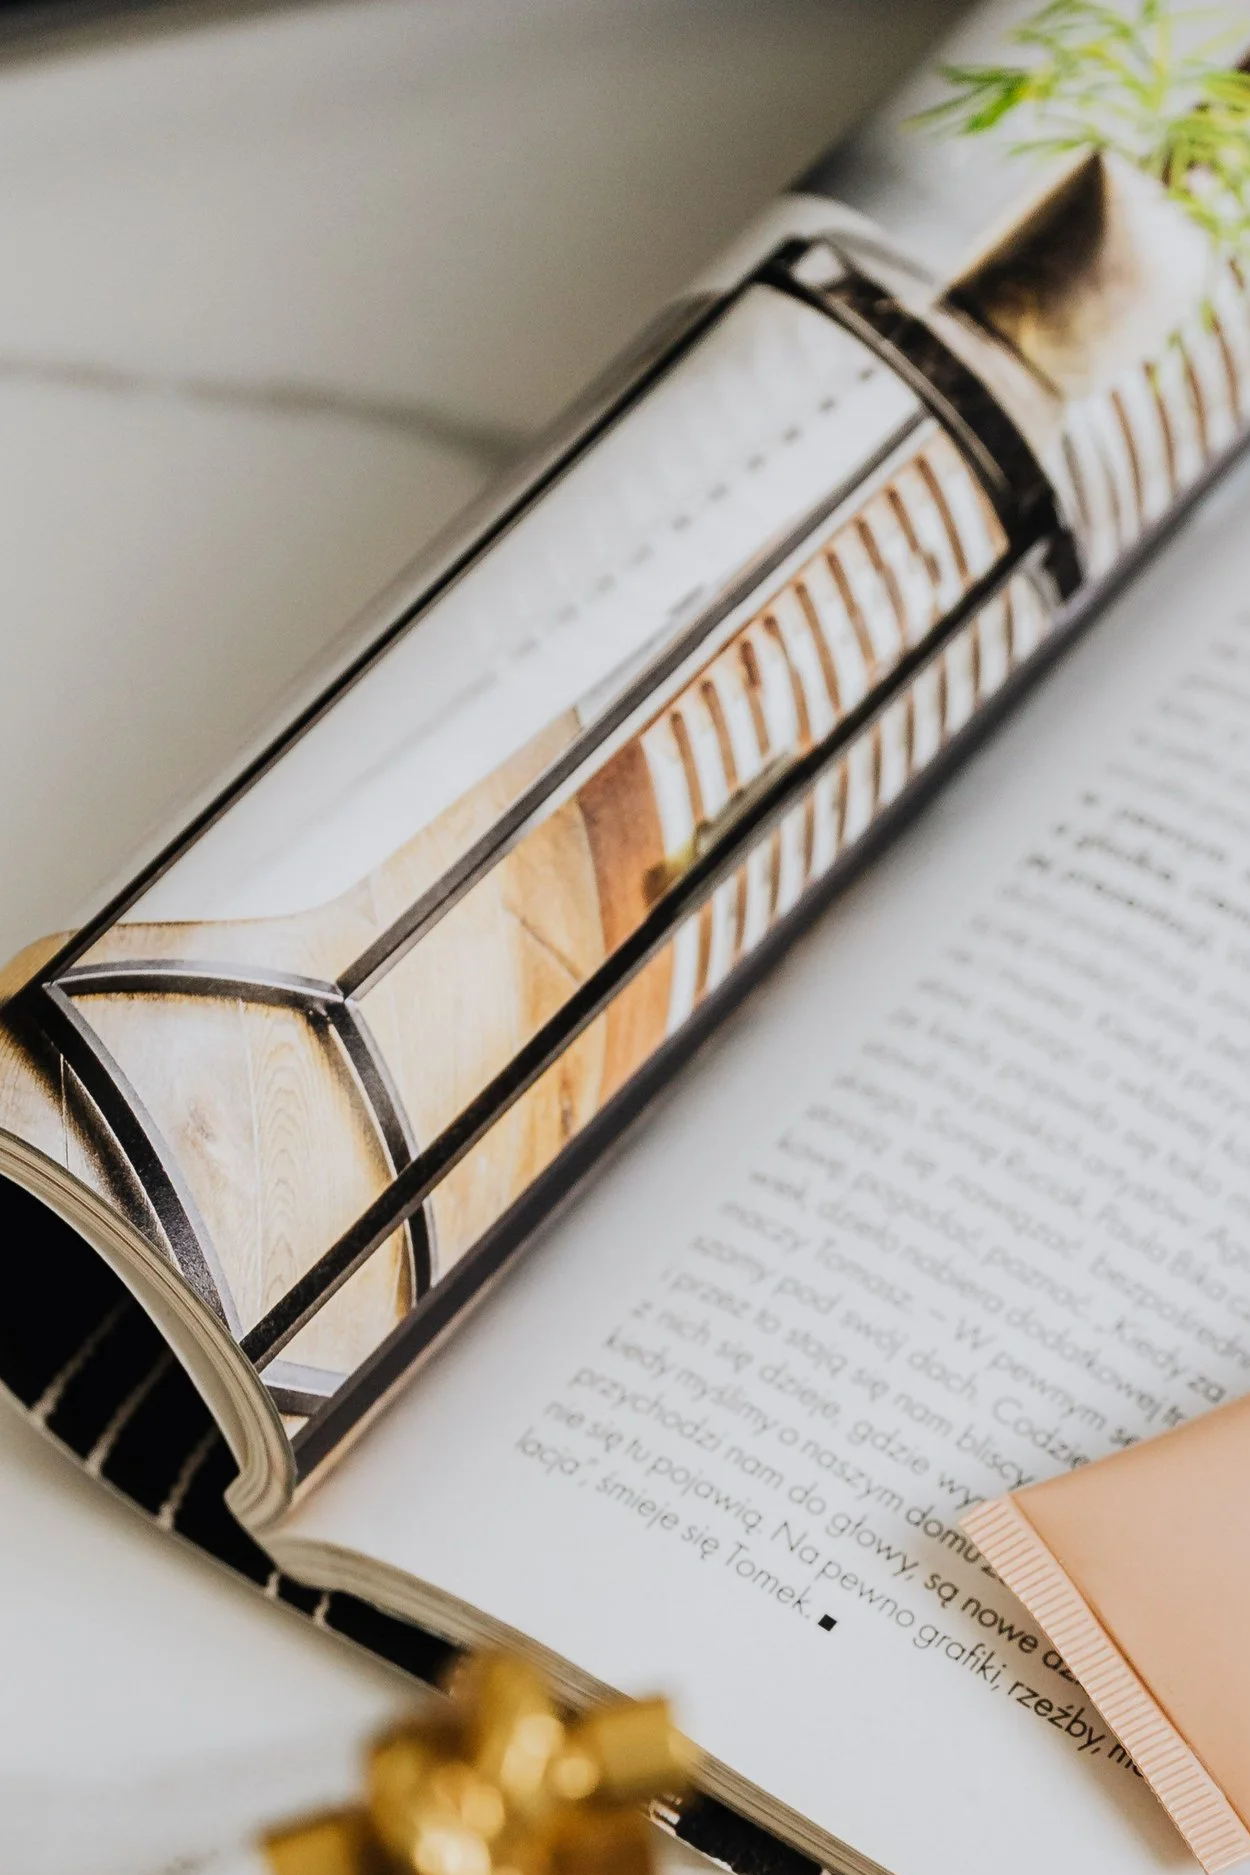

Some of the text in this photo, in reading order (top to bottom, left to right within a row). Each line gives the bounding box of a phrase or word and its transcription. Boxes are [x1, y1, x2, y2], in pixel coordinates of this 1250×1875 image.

[654, 1308, 712, 1347] nich
[713, 1339, 755, 1375] się
[756, 1361, 842, 1427] dzieje,
[844, 1418, 931, 1477] gdzie
[667, 1270, 752, 1320] przez
[751, 1306, 782, 1335] to
[782, 1327, 849, 1380] stają
[848, 1366, 891, 1404] się
[890, 1390, 955, 1439] nam
[770, 1274, 843, 1316] pod
[837, 1308, 909, 1363] swój
[904, 1346, 979, 1406] dach.
[897, 1243, 1006, 1316] nabiera
[1004, 1307, 1170, 1426] dodatkowej
[952, 1315, 997, 1353] W
[984, 1349, 1109, 1433] pewnym
[565, 1365, 727, 1453] przychodzi
[722, 1444, 786, 1491] nam
[785, 1480, 828, 1517] do
[824, 1513, 922, 1582] głowy,
[923, 1572, 960, 1609] są
[960, 1596, 1039, 1654] nowe
[601, 1325, 676, 1380] kiedy
[673, 1366, 780, 1438] myślimy
[775, 1425, 801, 1447] o
[798, 1438, 906, 1516] naszym
[904, 1506, 982, 1564] domu
[542, 1399, 586, 1430] nie
[583, 1419, 625, 1455] się
[622, 1435, 652, 1464] tu
[643, 1454, 765, 1537] pojawią.
[768, 1518, 821, 1567] Na
[812, 1558, 917, 1629] pewno
[912, 1624, 1007, 1691] grafiki,
[1006, 1680, 1107, 1755] rzeźby,
[593, 1470, 681, 1531] śmieje
[679, 1523, 721, 1562] się
[723, 1539, 812, 1620] Tomek.
